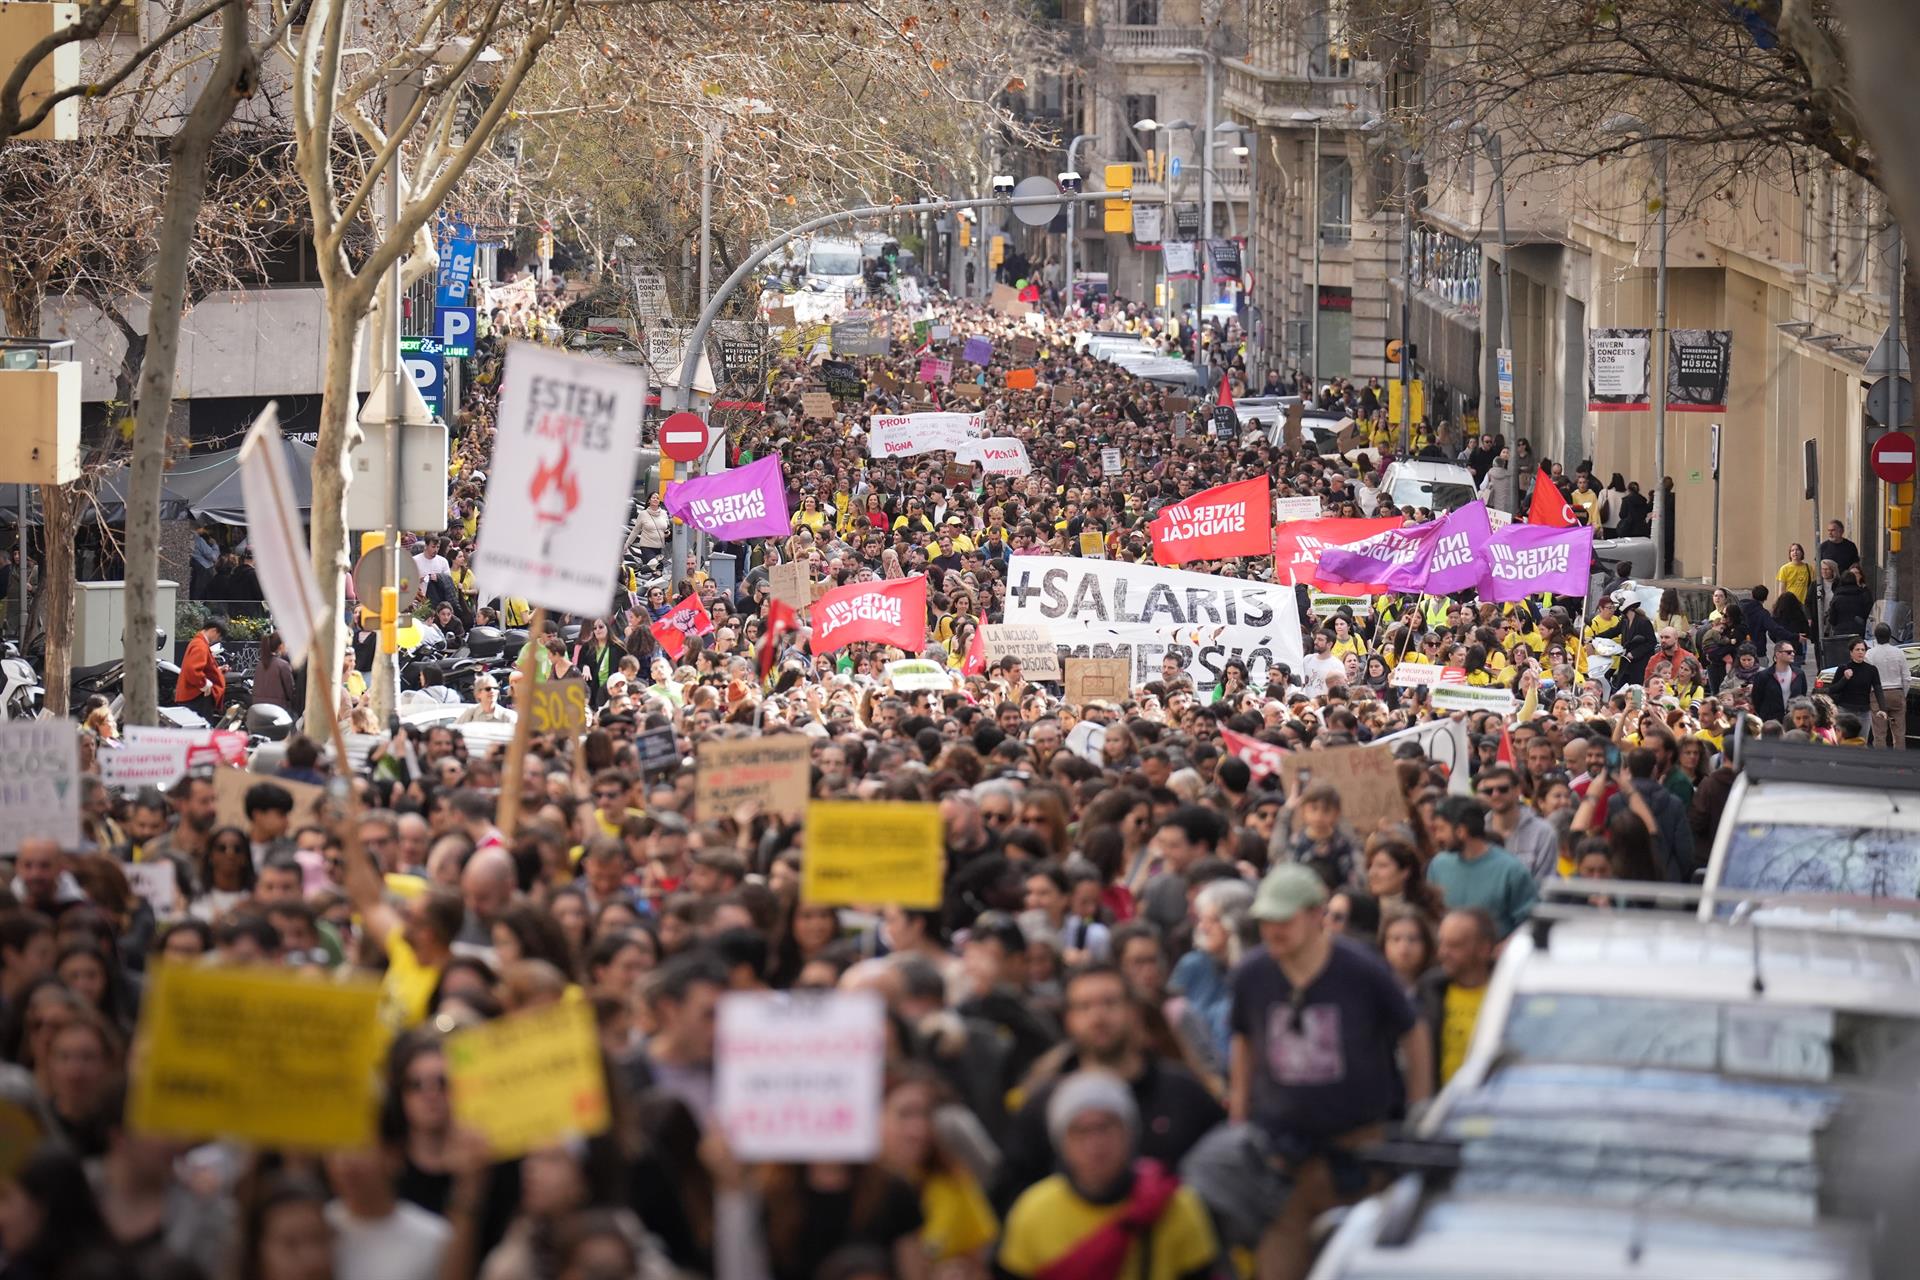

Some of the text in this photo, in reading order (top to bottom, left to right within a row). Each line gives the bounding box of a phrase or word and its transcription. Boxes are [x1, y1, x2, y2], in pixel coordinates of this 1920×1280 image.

[449, 254, 471, 298] DiR
[444, 311, 470, 345] P
[400, 341, 421, 350] BERT
[1681, 359, 1717, 368] MÚSICA
[405, 359, 437, 388] P
[531, 376, 617, 421] ESTEM
[525, 406, 612, 451] FARTES
[879, 417, 911, 429] PROU!
[884, 440, 913, 453] DiGNA
[1011, 568, 1273, 628] +SALARIS
[987, 631, 1000, 641] LA
[994, 644, 1006, 655] NO
[1022, 644, 1035, 653] SER
[1402, 667, 1434, 675] recursos
[1401, 675, 1434, 684] educació
[116, 753, 172, 764] recursos
[115, 766, 175, 779] educació
